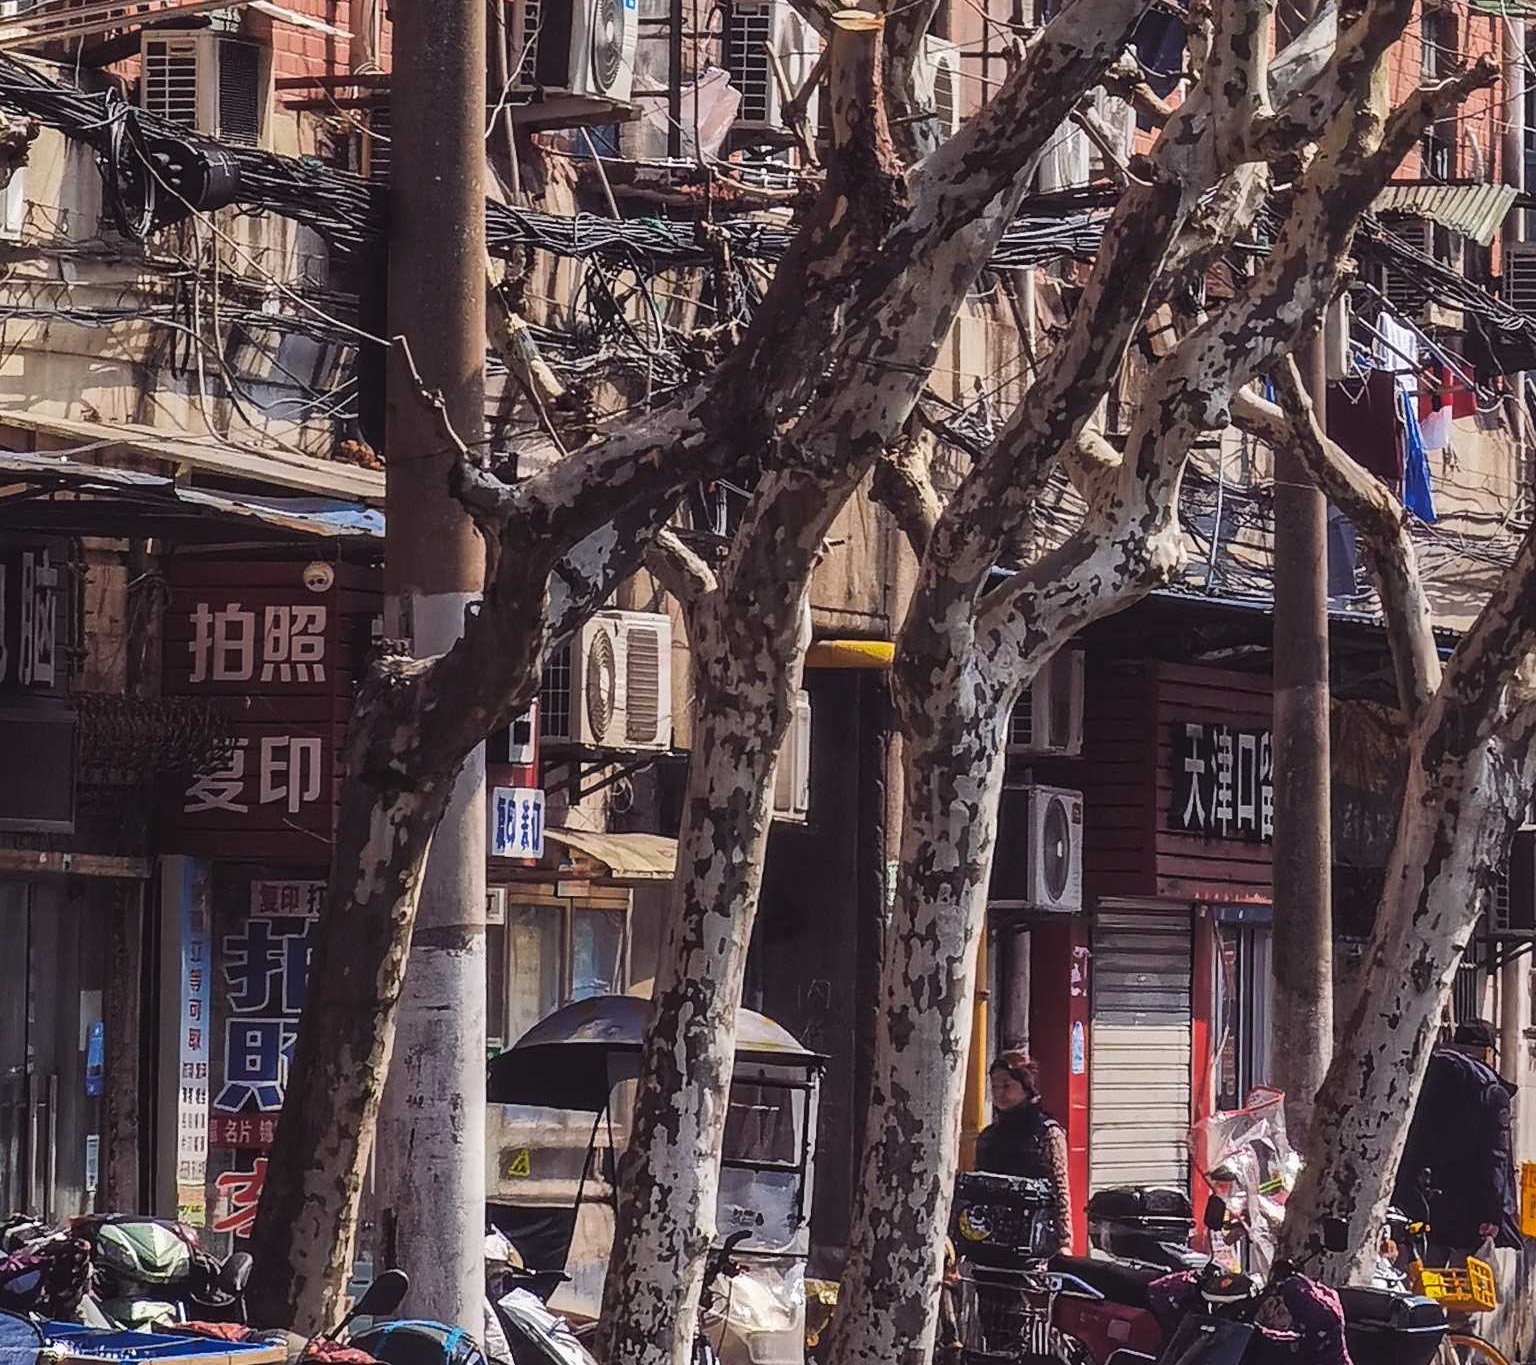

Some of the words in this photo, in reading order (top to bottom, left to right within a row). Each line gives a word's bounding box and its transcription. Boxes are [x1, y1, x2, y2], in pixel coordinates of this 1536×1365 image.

[189, 603, 326, 682] 拍照
[184, 735, 322, 813] 复印
[224, 1119, 252, 1143] 名片
